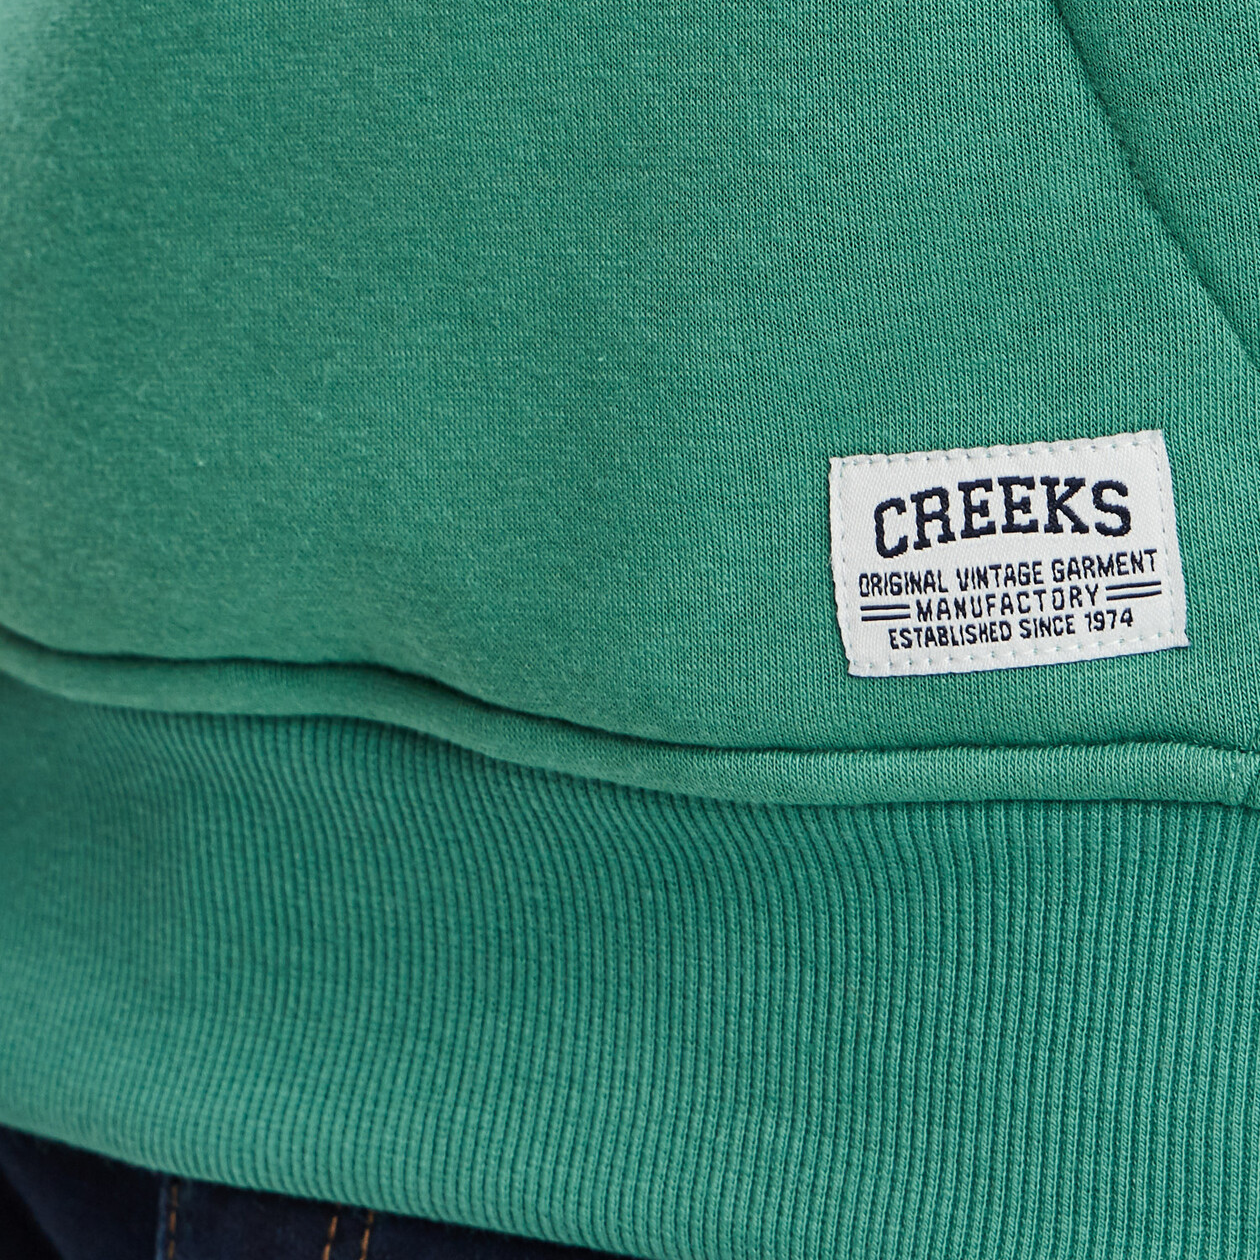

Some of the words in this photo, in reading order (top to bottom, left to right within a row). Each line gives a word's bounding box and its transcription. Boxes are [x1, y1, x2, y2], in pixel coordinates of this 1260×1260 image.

[874, 476, 1132, 558] CREEKS
[859, 569, 948, 598] ORIGINAL
[956, 561, 1045, 590] VINTAGE
[1052, 549, 1157, 583] GARMENT
[916, 584, 1099, 622] MANUFACTORY
[889, 620, 1011, 650] ESTABLISHED
[1019, 614, 1076, 639] SINCE
[1085, 607, 1134, 631] 1974
